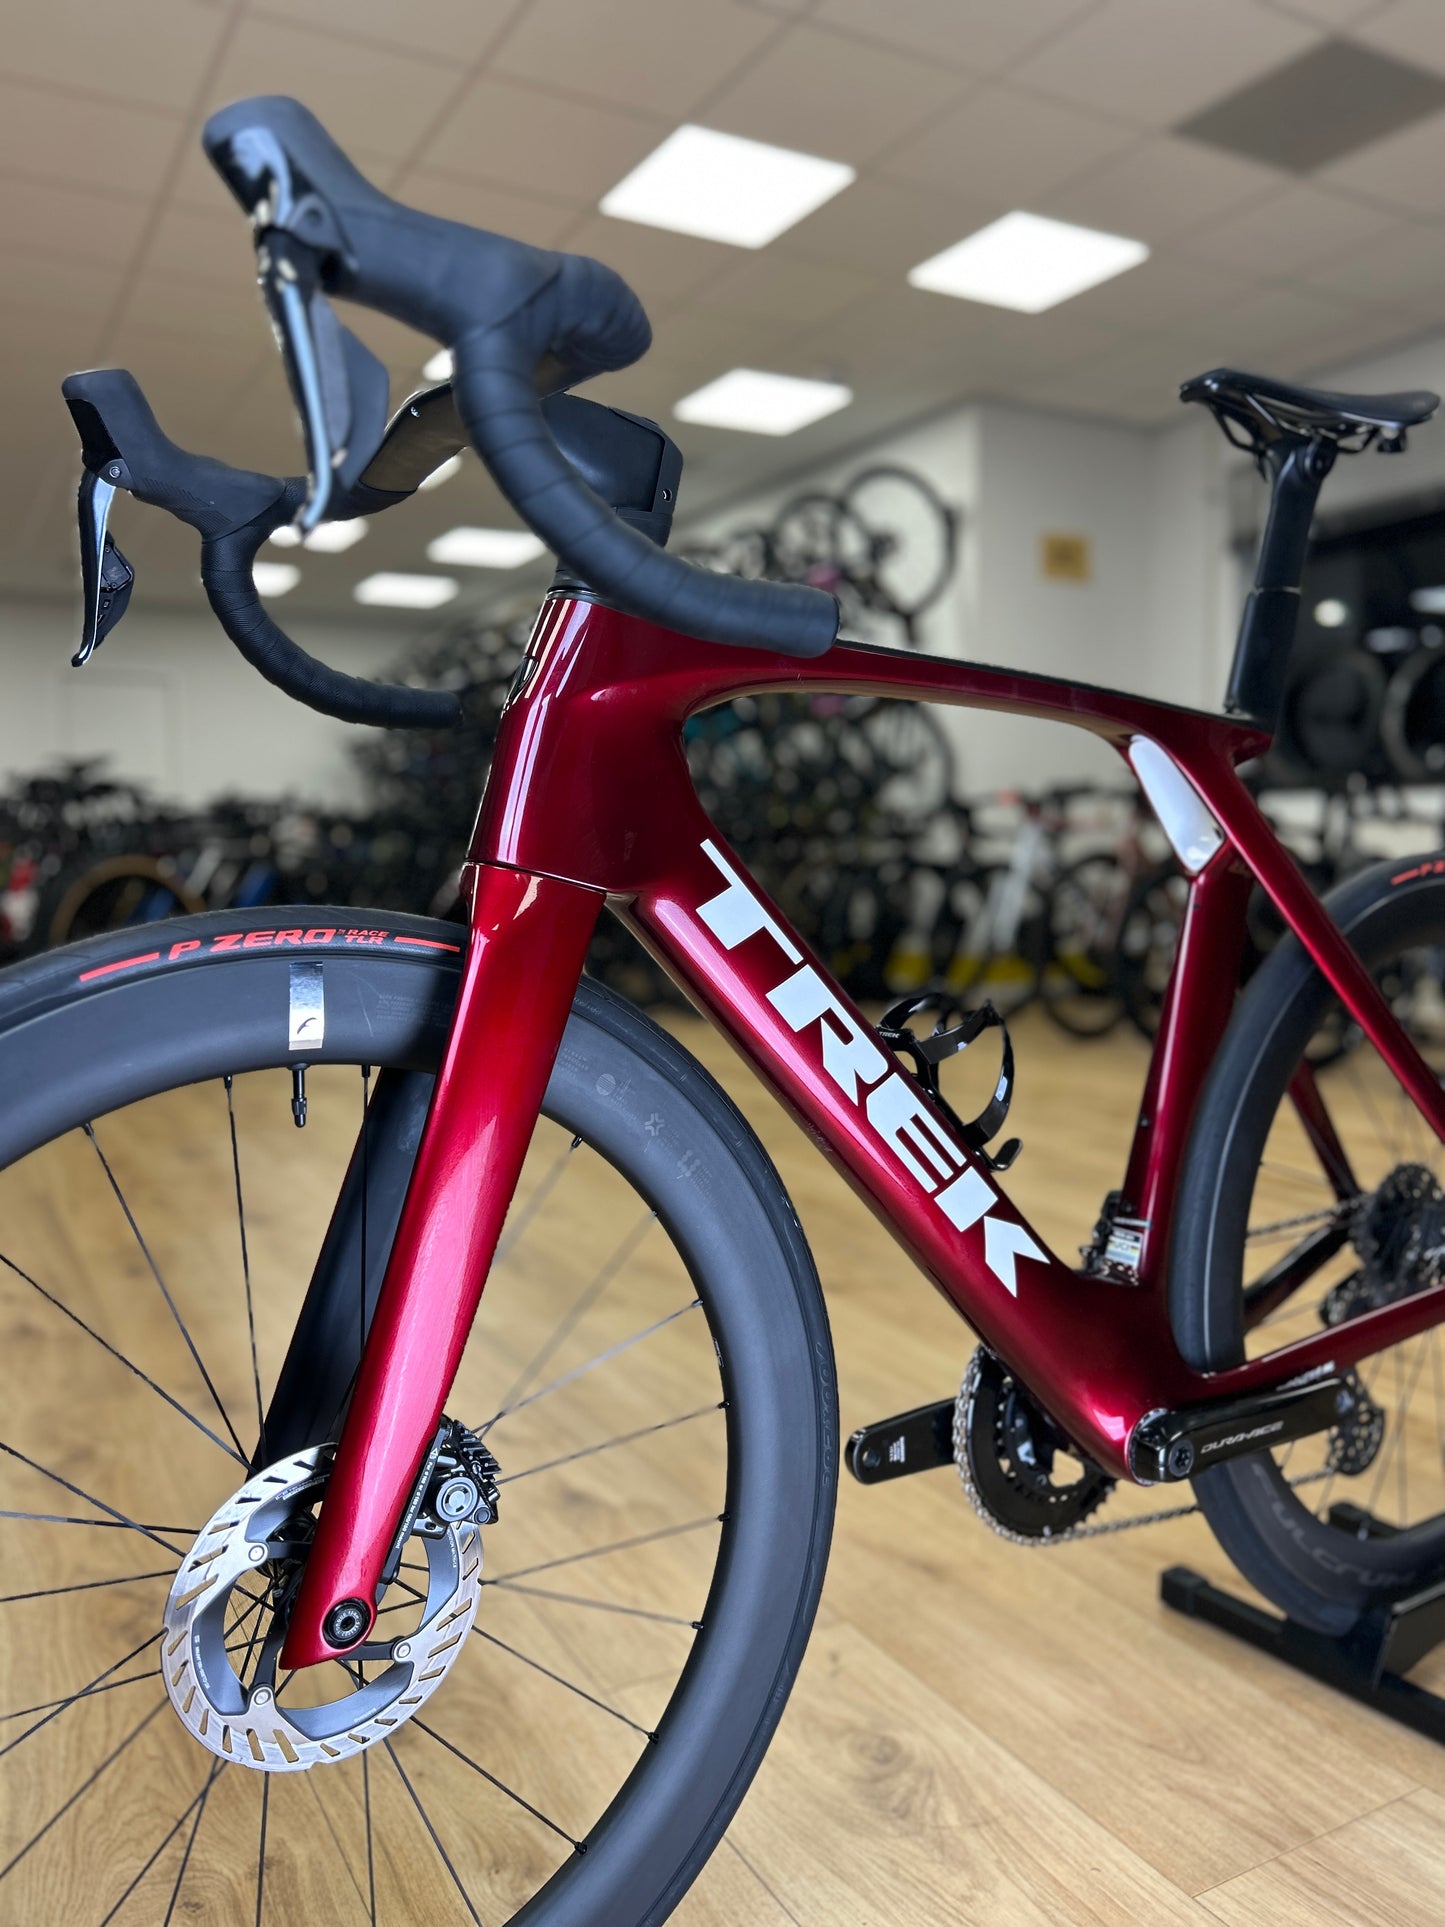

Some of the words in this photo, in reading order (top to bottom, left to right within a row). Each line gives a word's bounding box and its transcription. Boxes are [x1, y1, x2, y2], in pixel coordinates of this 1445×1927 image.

[344, 934, 385, 945] TLR
[347, 928, 390, 937] RACE
[167, 939, 202, 961] P
[209, 928, 337, 953] ZERO
[878, 1031, 900, 1039] TREK
[695, 838, 1050, 1297] TREK
[1199, 1420, 1285, 1455] DURA-ACE
